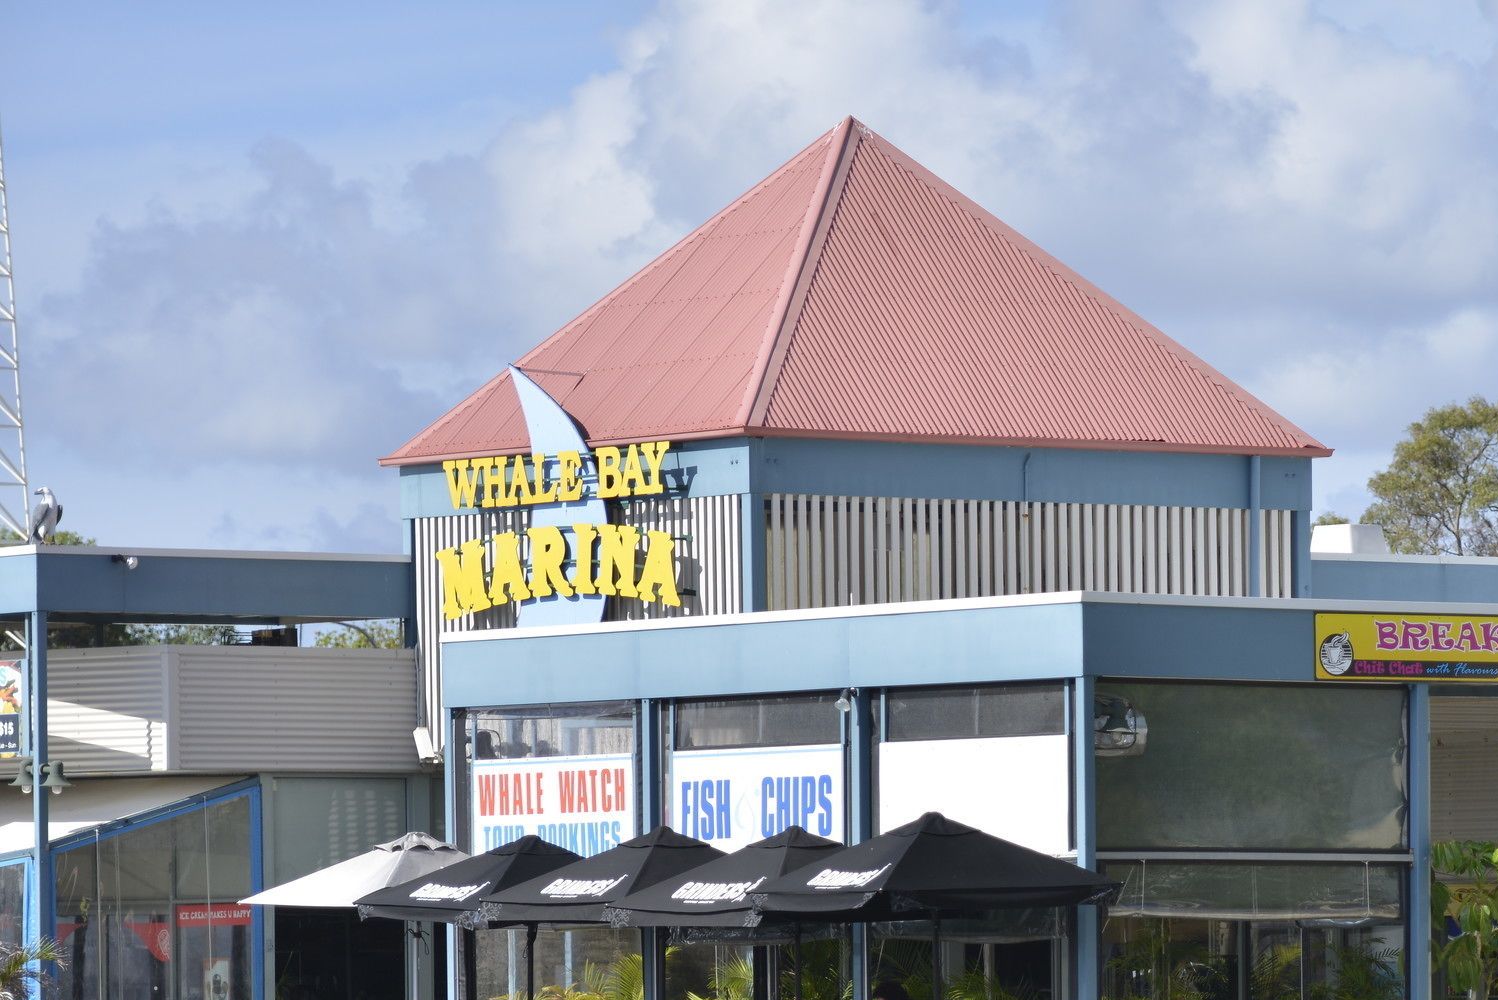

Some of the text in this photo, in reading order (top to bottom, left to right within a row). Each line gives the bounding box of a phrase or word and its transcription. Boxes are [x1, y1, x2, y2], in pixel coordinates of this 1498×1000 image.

[443, 441, 670, 509] WHALE BAY
[436, 524, 681, 620] MARINA
[1354, 661, 1385, 674] Chit
[1389, 661, 1423, 675] Chat
[1426, 662, 1450, 675] with
[478, 768, 625, 816] WHALE WATCH
[682, 774, 833, 840] FISH CHIPS
